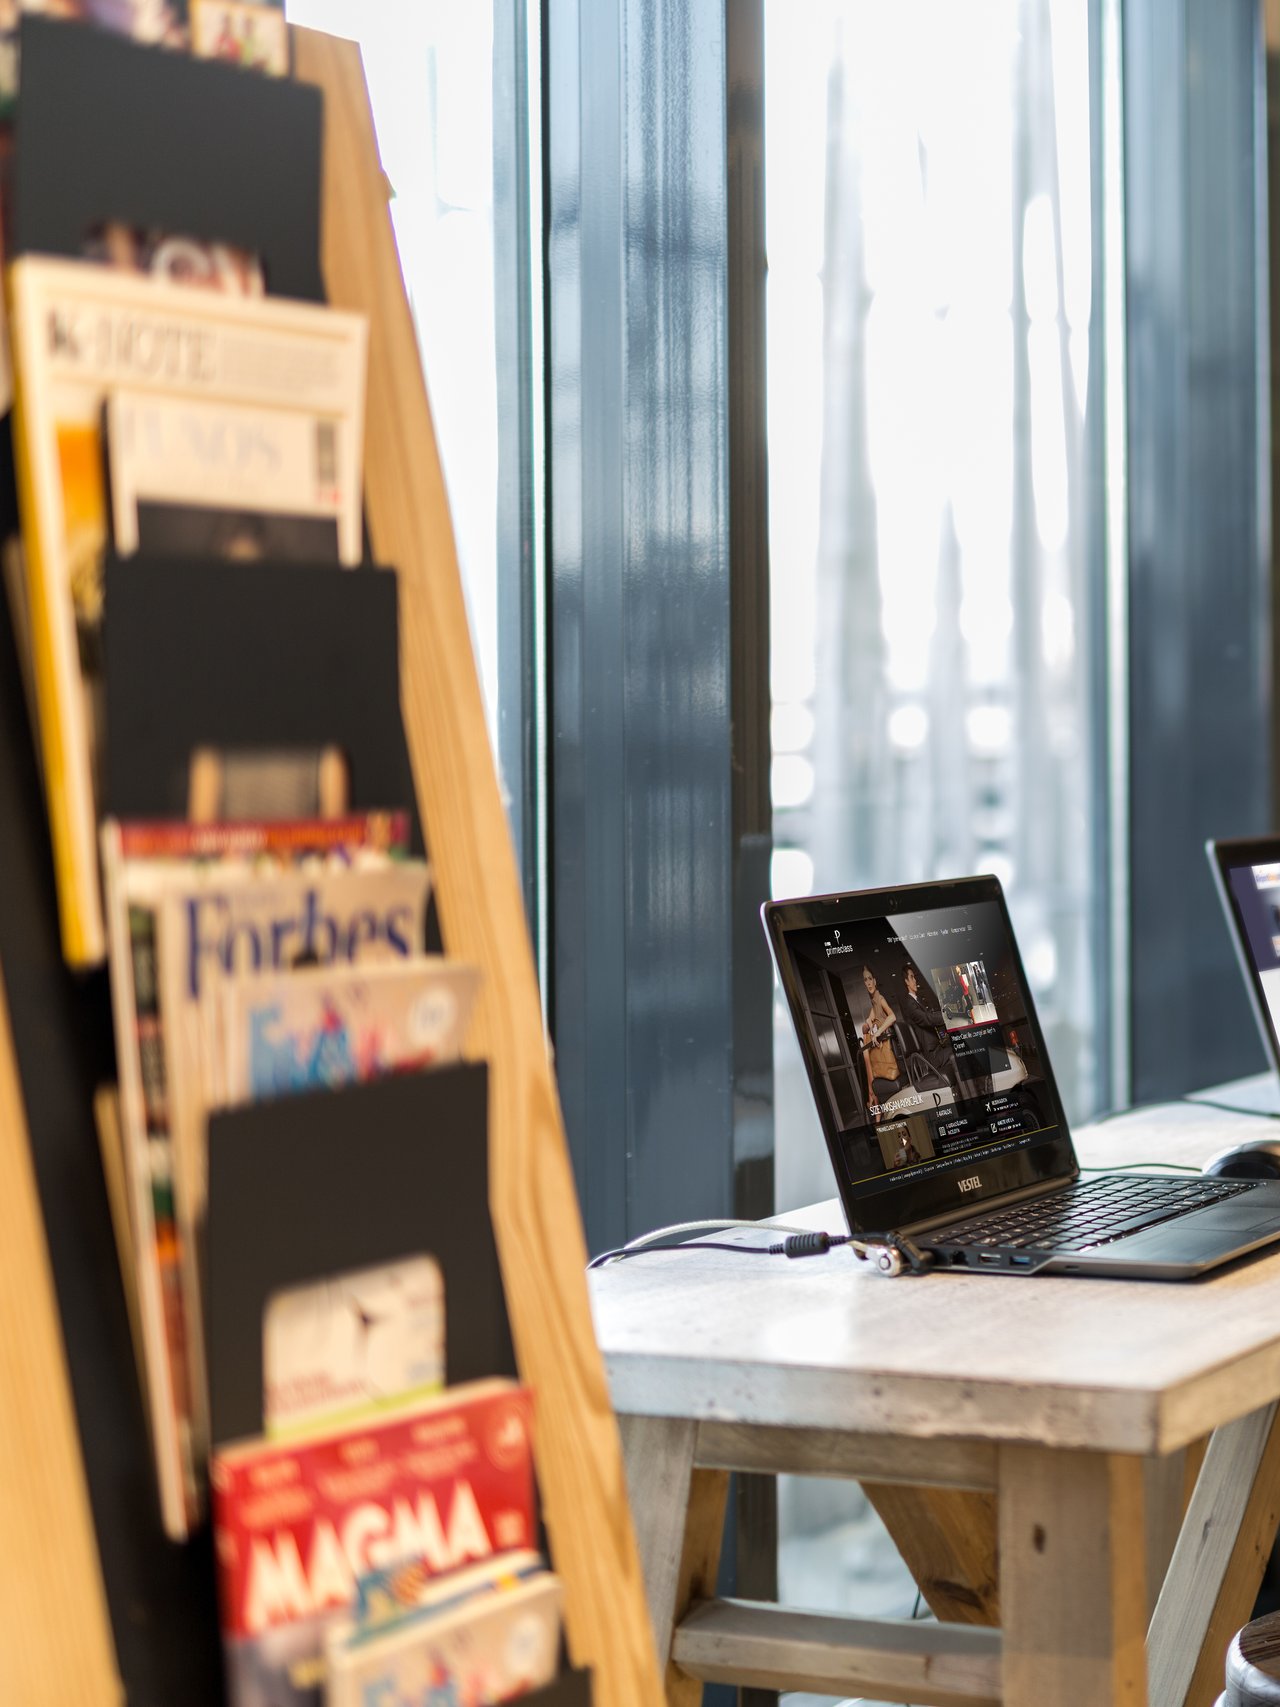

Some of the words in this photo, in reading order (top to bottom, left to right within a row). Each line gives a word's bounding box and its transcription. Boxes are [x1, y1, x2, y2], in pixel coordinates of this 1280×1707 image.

[184, 886, 413, 1002] Forbes
[957, 1175, 983, 1193] VESTEL
[245, 1480, 496, 1634] MAGMA
